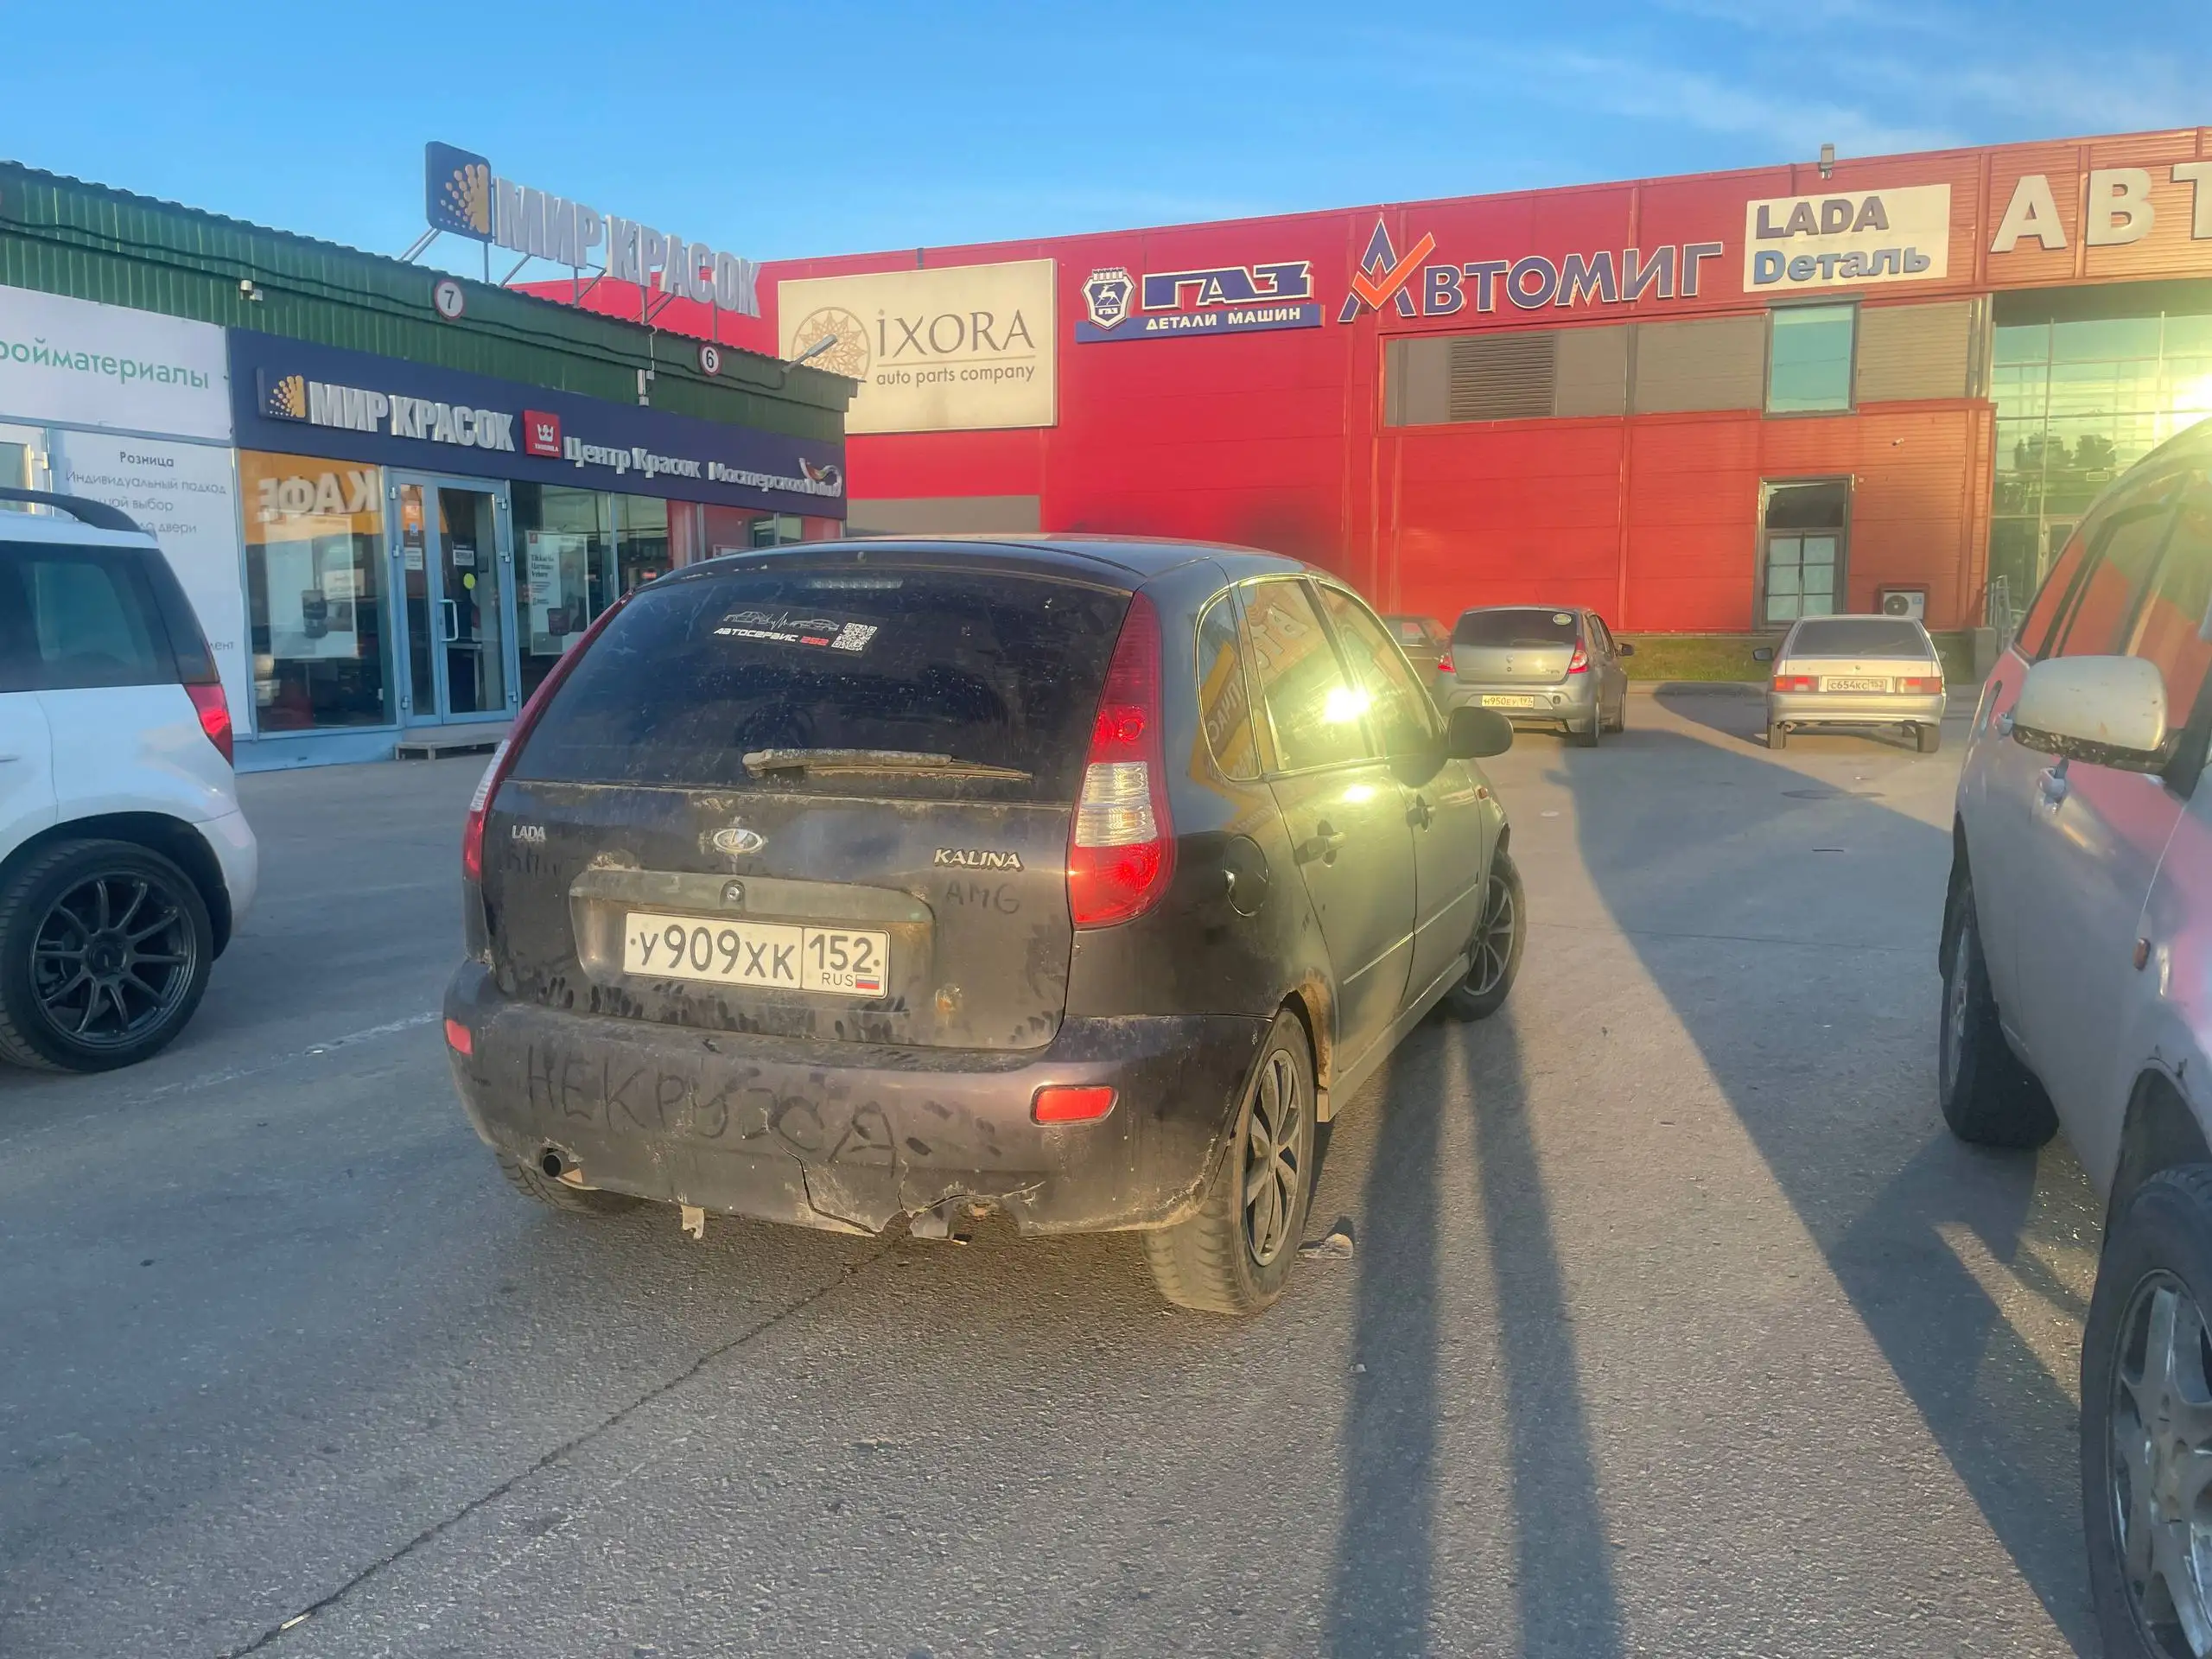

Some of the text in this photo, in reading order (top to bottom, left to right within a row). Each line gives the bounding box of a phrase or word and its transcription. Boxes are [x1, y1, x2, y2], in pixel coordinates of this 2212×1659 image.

[1756, 196, 1890, 239] LADA
[493, 176, 761, 318] МИР КРАСОК
[1338, 218, 1724, 322] АВТОМИГ
[1142, 261, 1312, 309] ГАЗ
[443, 289, 455, 309] 7
[1146, 307, 1300, 331] ДЕТАЛИ МАШИН
[705, 350, 715, 369] 6
[876, 365, 1036, 388] auto parts company
[307, 380, 516, 452] МИР КРАСОК
[119, 451, 175, 467] Розница
[563, 435, 630, 474] Центр
[632, 447, 701, 478] Красок
[66, 471, 227, 495] Индивидуальный подход
[132, 498, 174, 512] выбор
[159, 523, 197, 537] двери
[714, 627, 798, 643] АВТОСЕРВИС
[512, 824, 547, 842] LADA
[934, 848, 1024, 872] KALINA
[945, 880, 1020, 914] AMG
[639, 924, 874, 981] У909ХК 152
[821, 972, 855, 988] RUS
